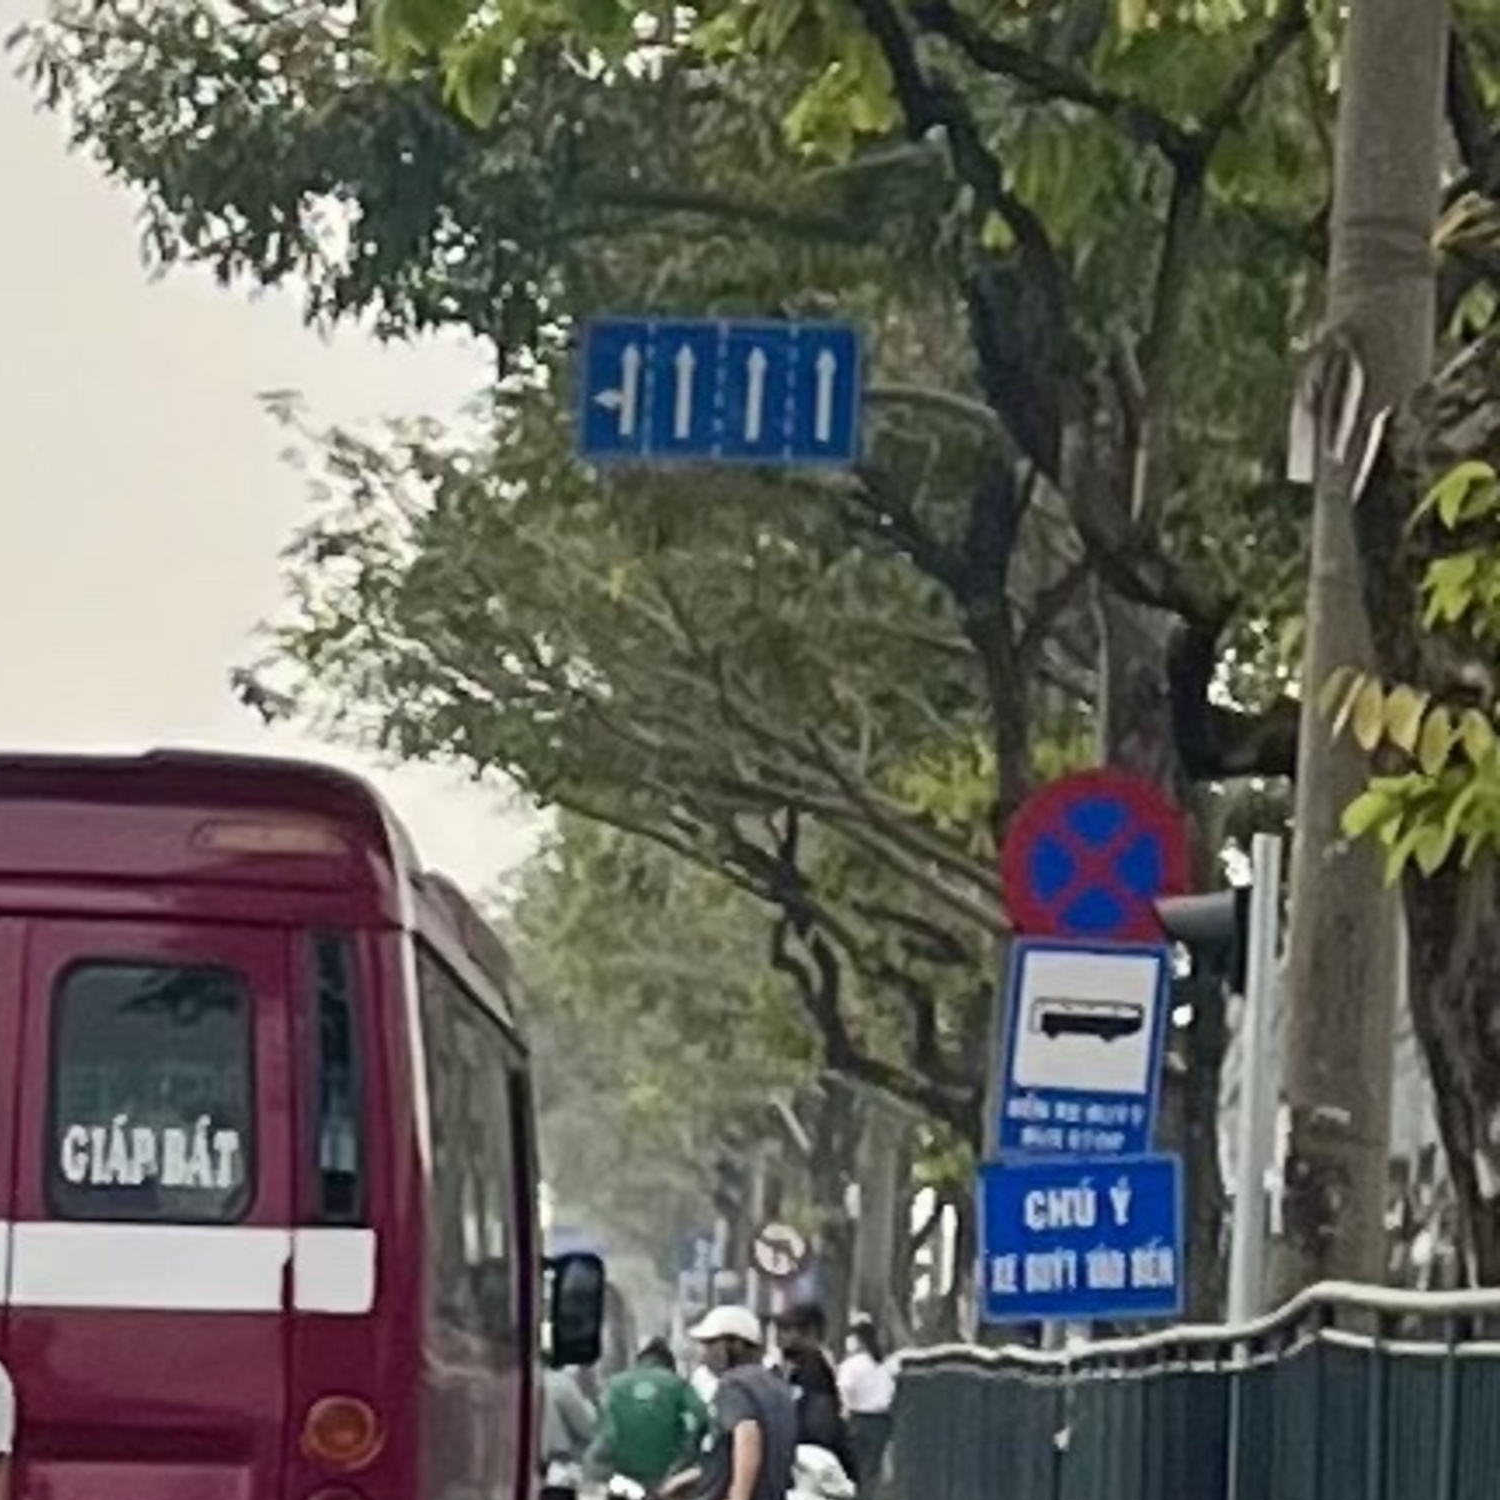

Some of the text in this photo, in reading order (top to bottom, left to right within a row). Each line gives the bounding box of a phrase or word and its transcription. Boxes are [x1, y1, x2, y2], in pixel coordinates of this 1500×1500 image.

[61, 1113, 240, 1189] GIÁP BÁT
[1024, 1175, 1132, 1231] CHÚ Ý
